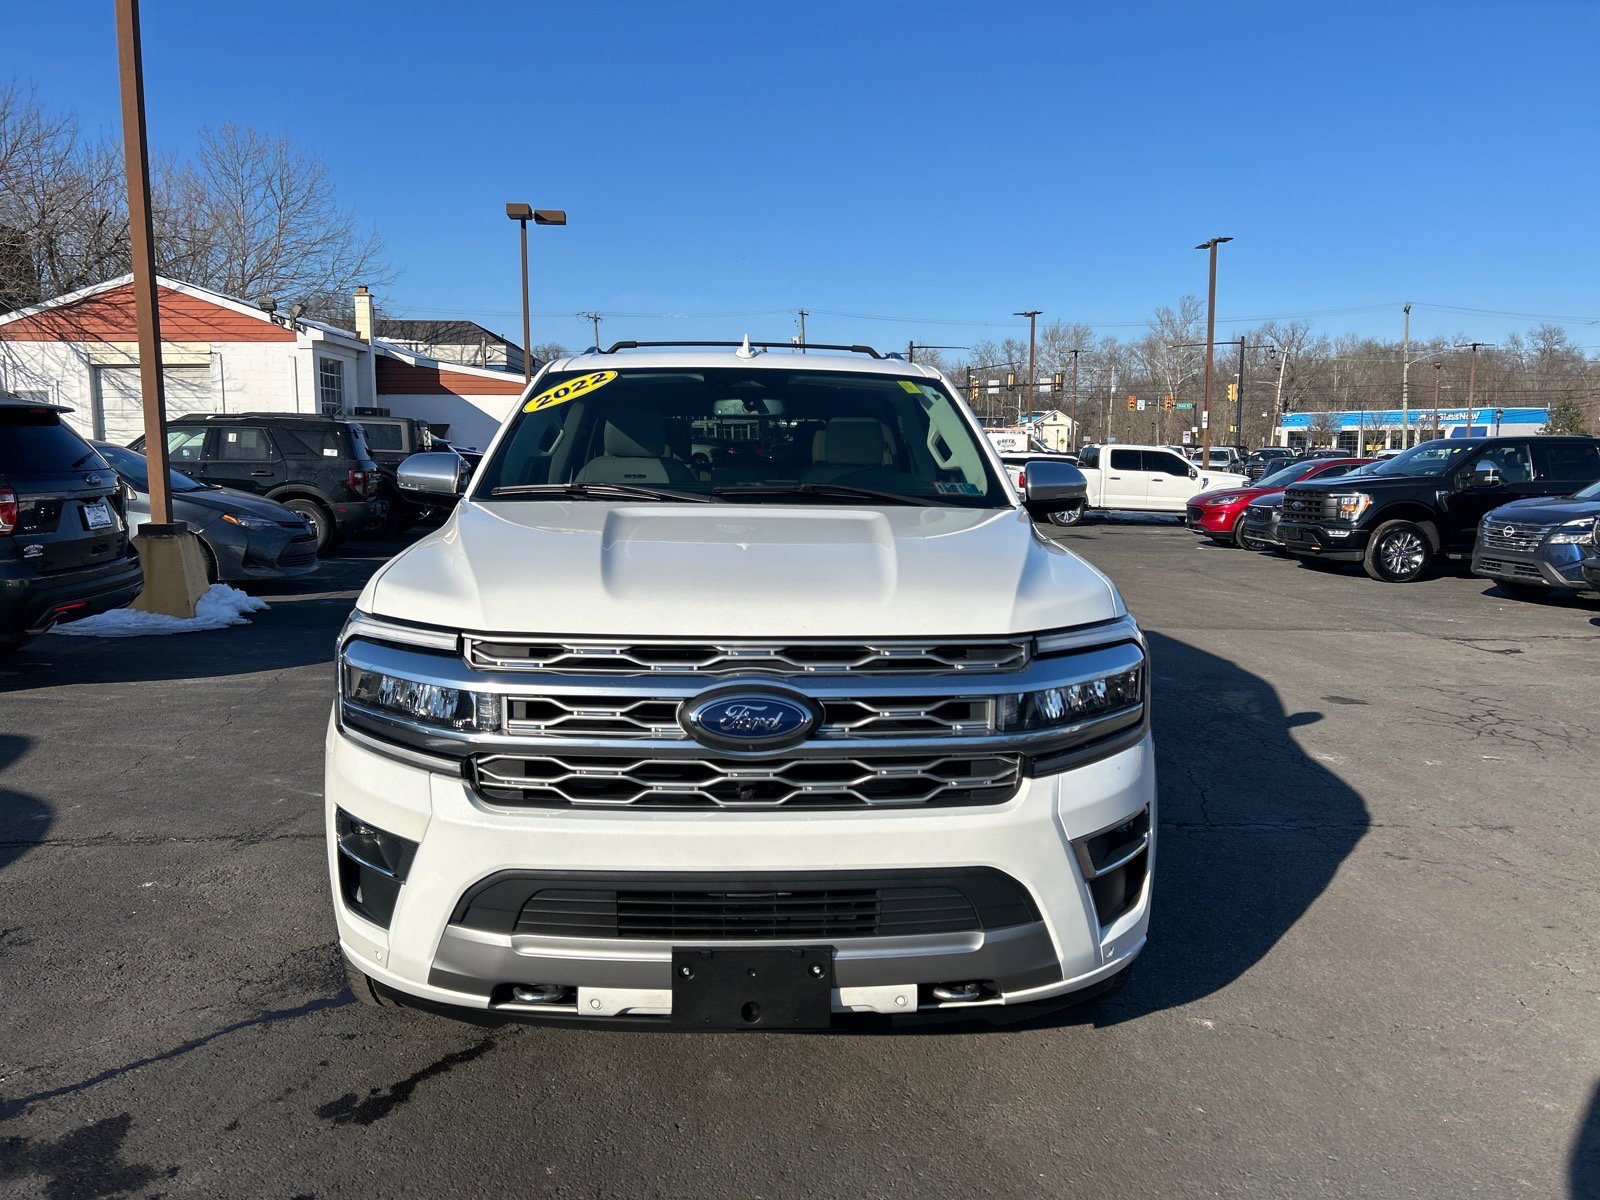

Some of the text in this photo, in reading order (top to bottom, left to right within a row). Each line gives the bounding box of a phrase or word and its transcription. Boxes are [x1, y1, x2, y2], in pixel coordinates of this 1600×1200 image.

[535, 371, 608, 409] 2022
[1418, 411, 1480, 422] AutGlassNw!
[719, 704, 784, 731] Ford
